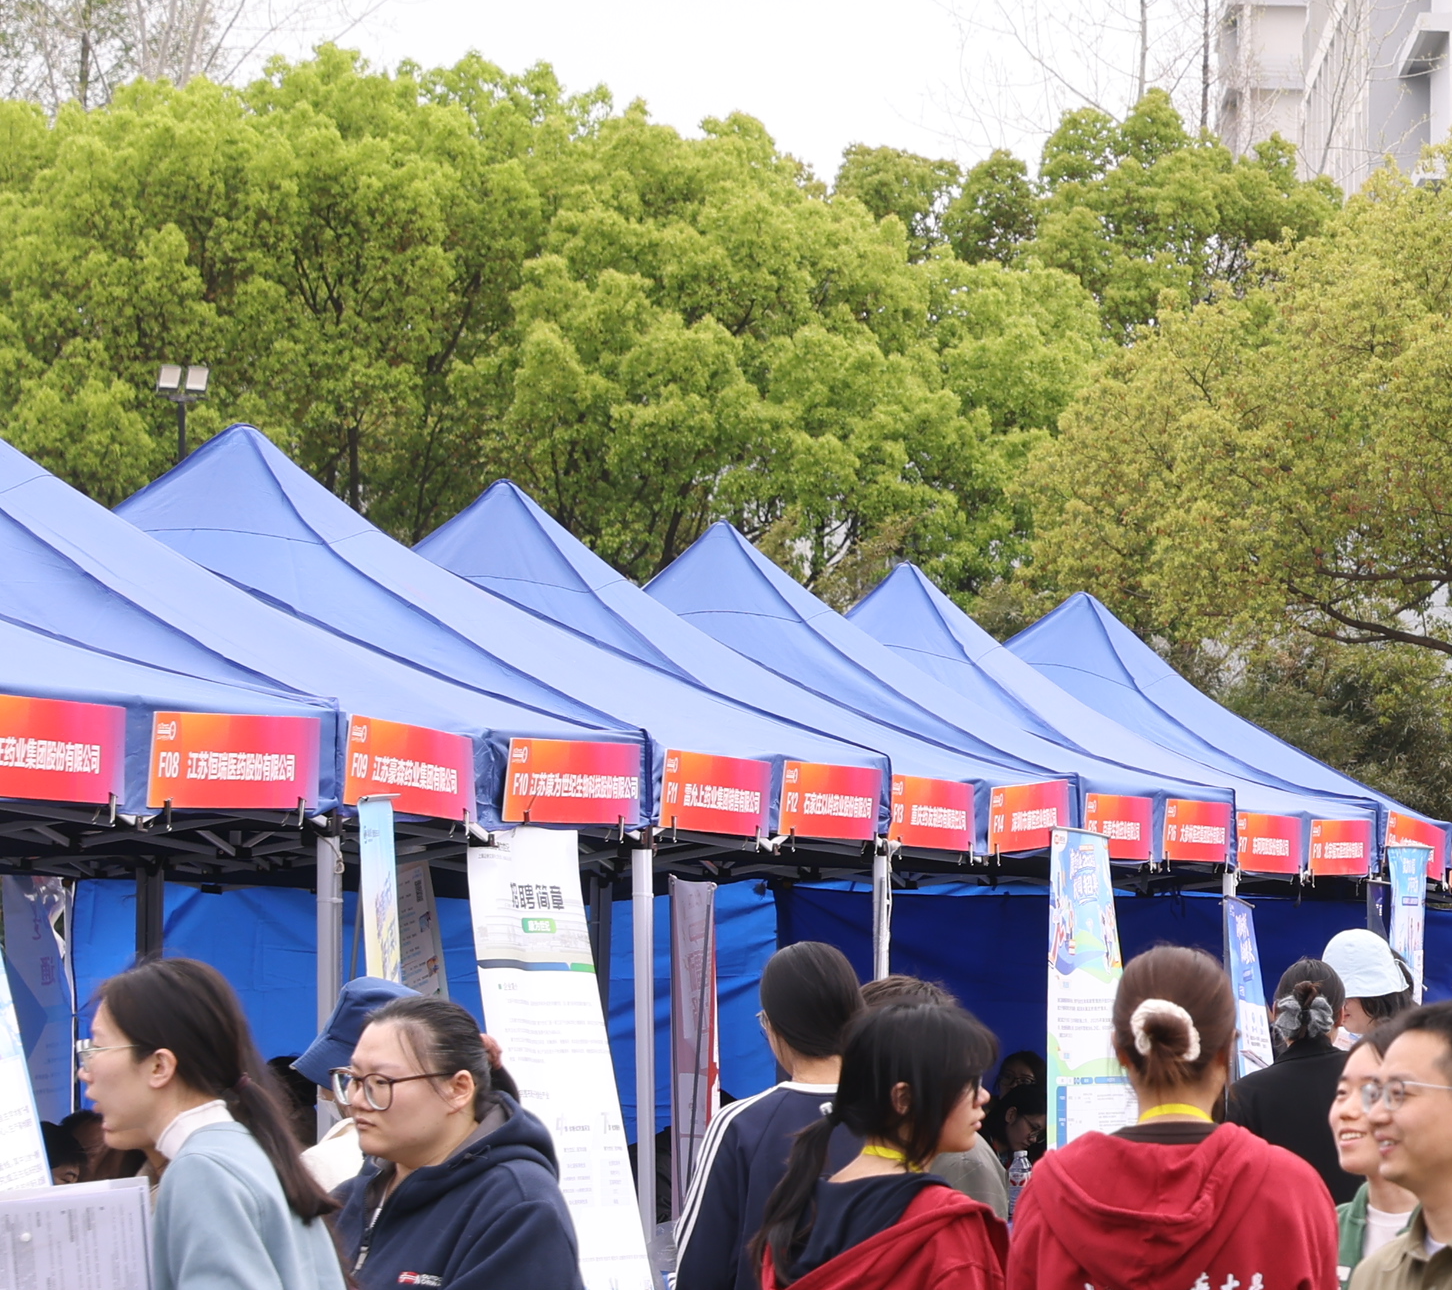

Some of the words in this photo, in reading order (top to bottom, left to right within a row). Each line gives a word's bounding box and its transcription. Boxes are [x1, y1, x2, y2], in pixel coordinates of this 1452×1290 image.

[158, 751, 180, 779] F08
[186, 752, 296, 782] 江苏恒瑞医药股份有限公司
[351, 752, 369, 779] F09
[371, 756, 459, 795] 江苏豪森药业集团有限公司
[512, 773, 529, 796] F10
[666, 782, 680, 804] F11
[786, 791, 799, 813] F12
